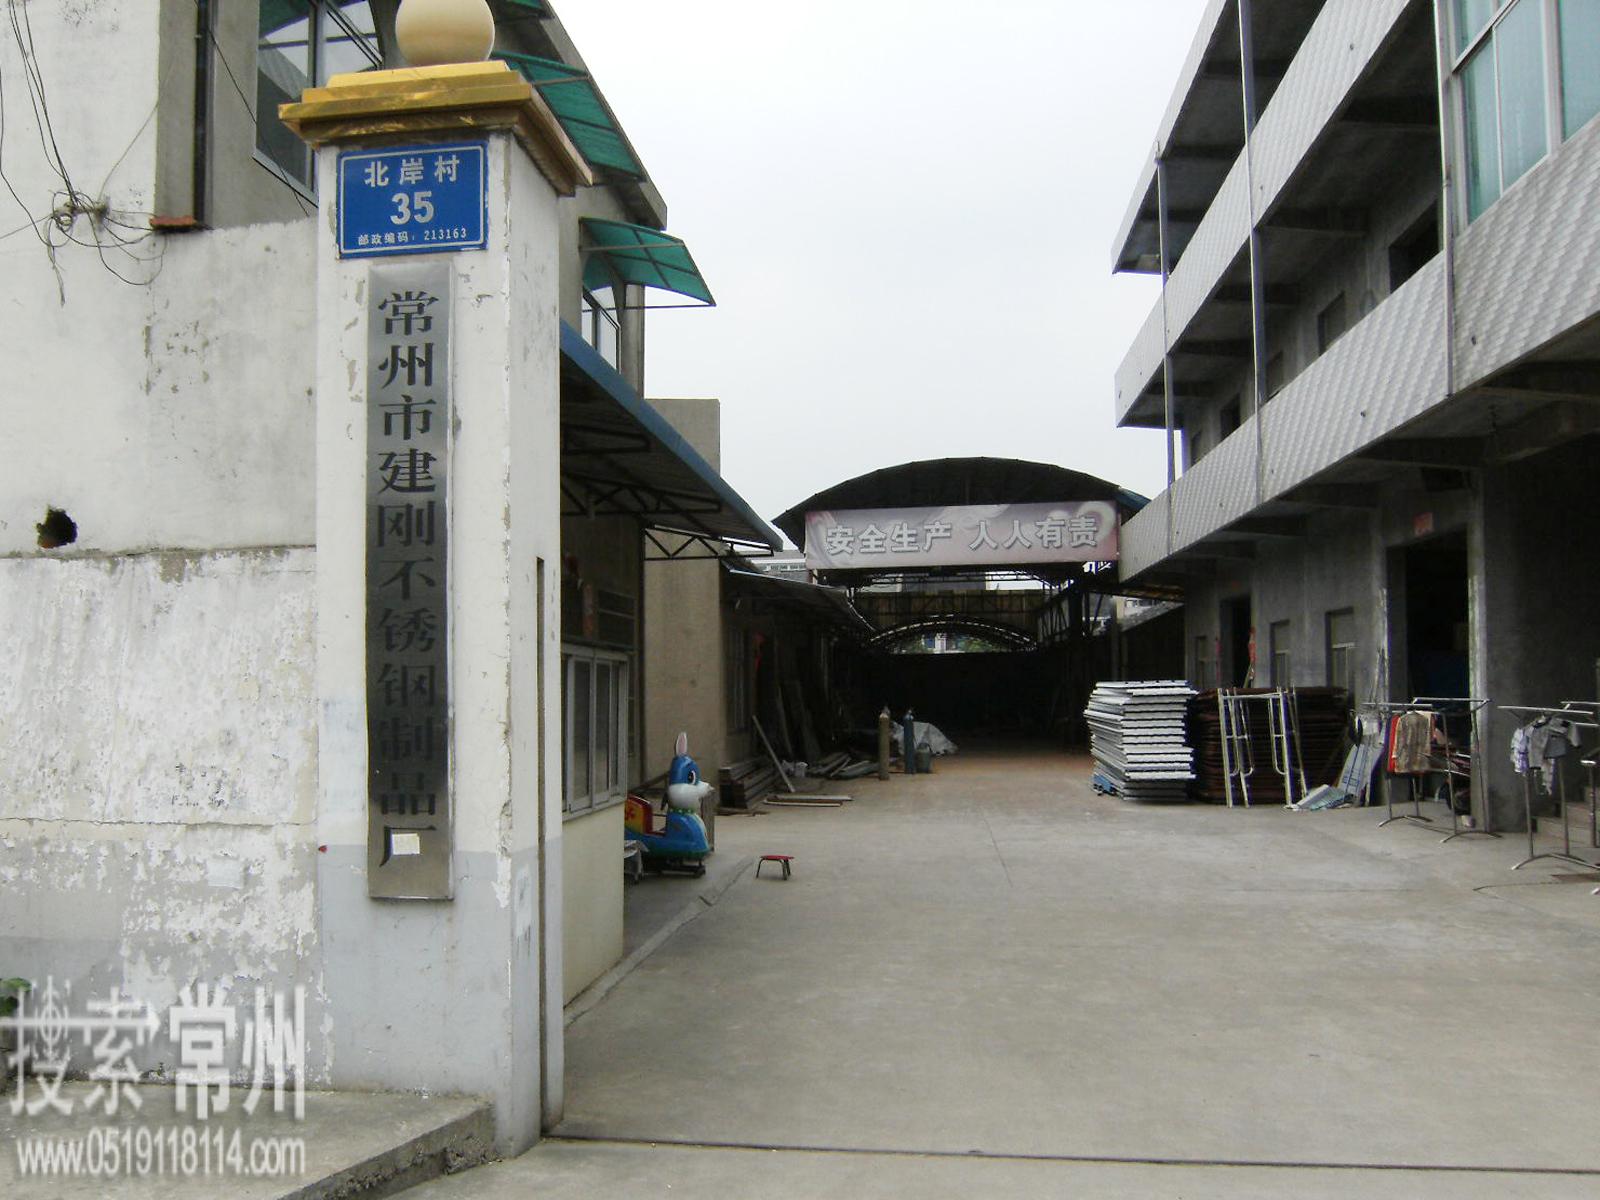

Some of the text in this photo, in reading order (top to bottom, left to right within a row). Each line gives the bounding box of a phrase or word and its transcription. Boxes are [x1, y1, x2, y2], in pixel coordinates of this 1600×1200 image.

[364, 155, 460, 188] 北岸村
[390, 191, 434, 225] 35
[424, 227, 467, 241] 213163
[826, 515, 1098, 555] 安全生产 人人有责
[375, 290, 440, 868] 常州市建刚不锈钢制品厂
